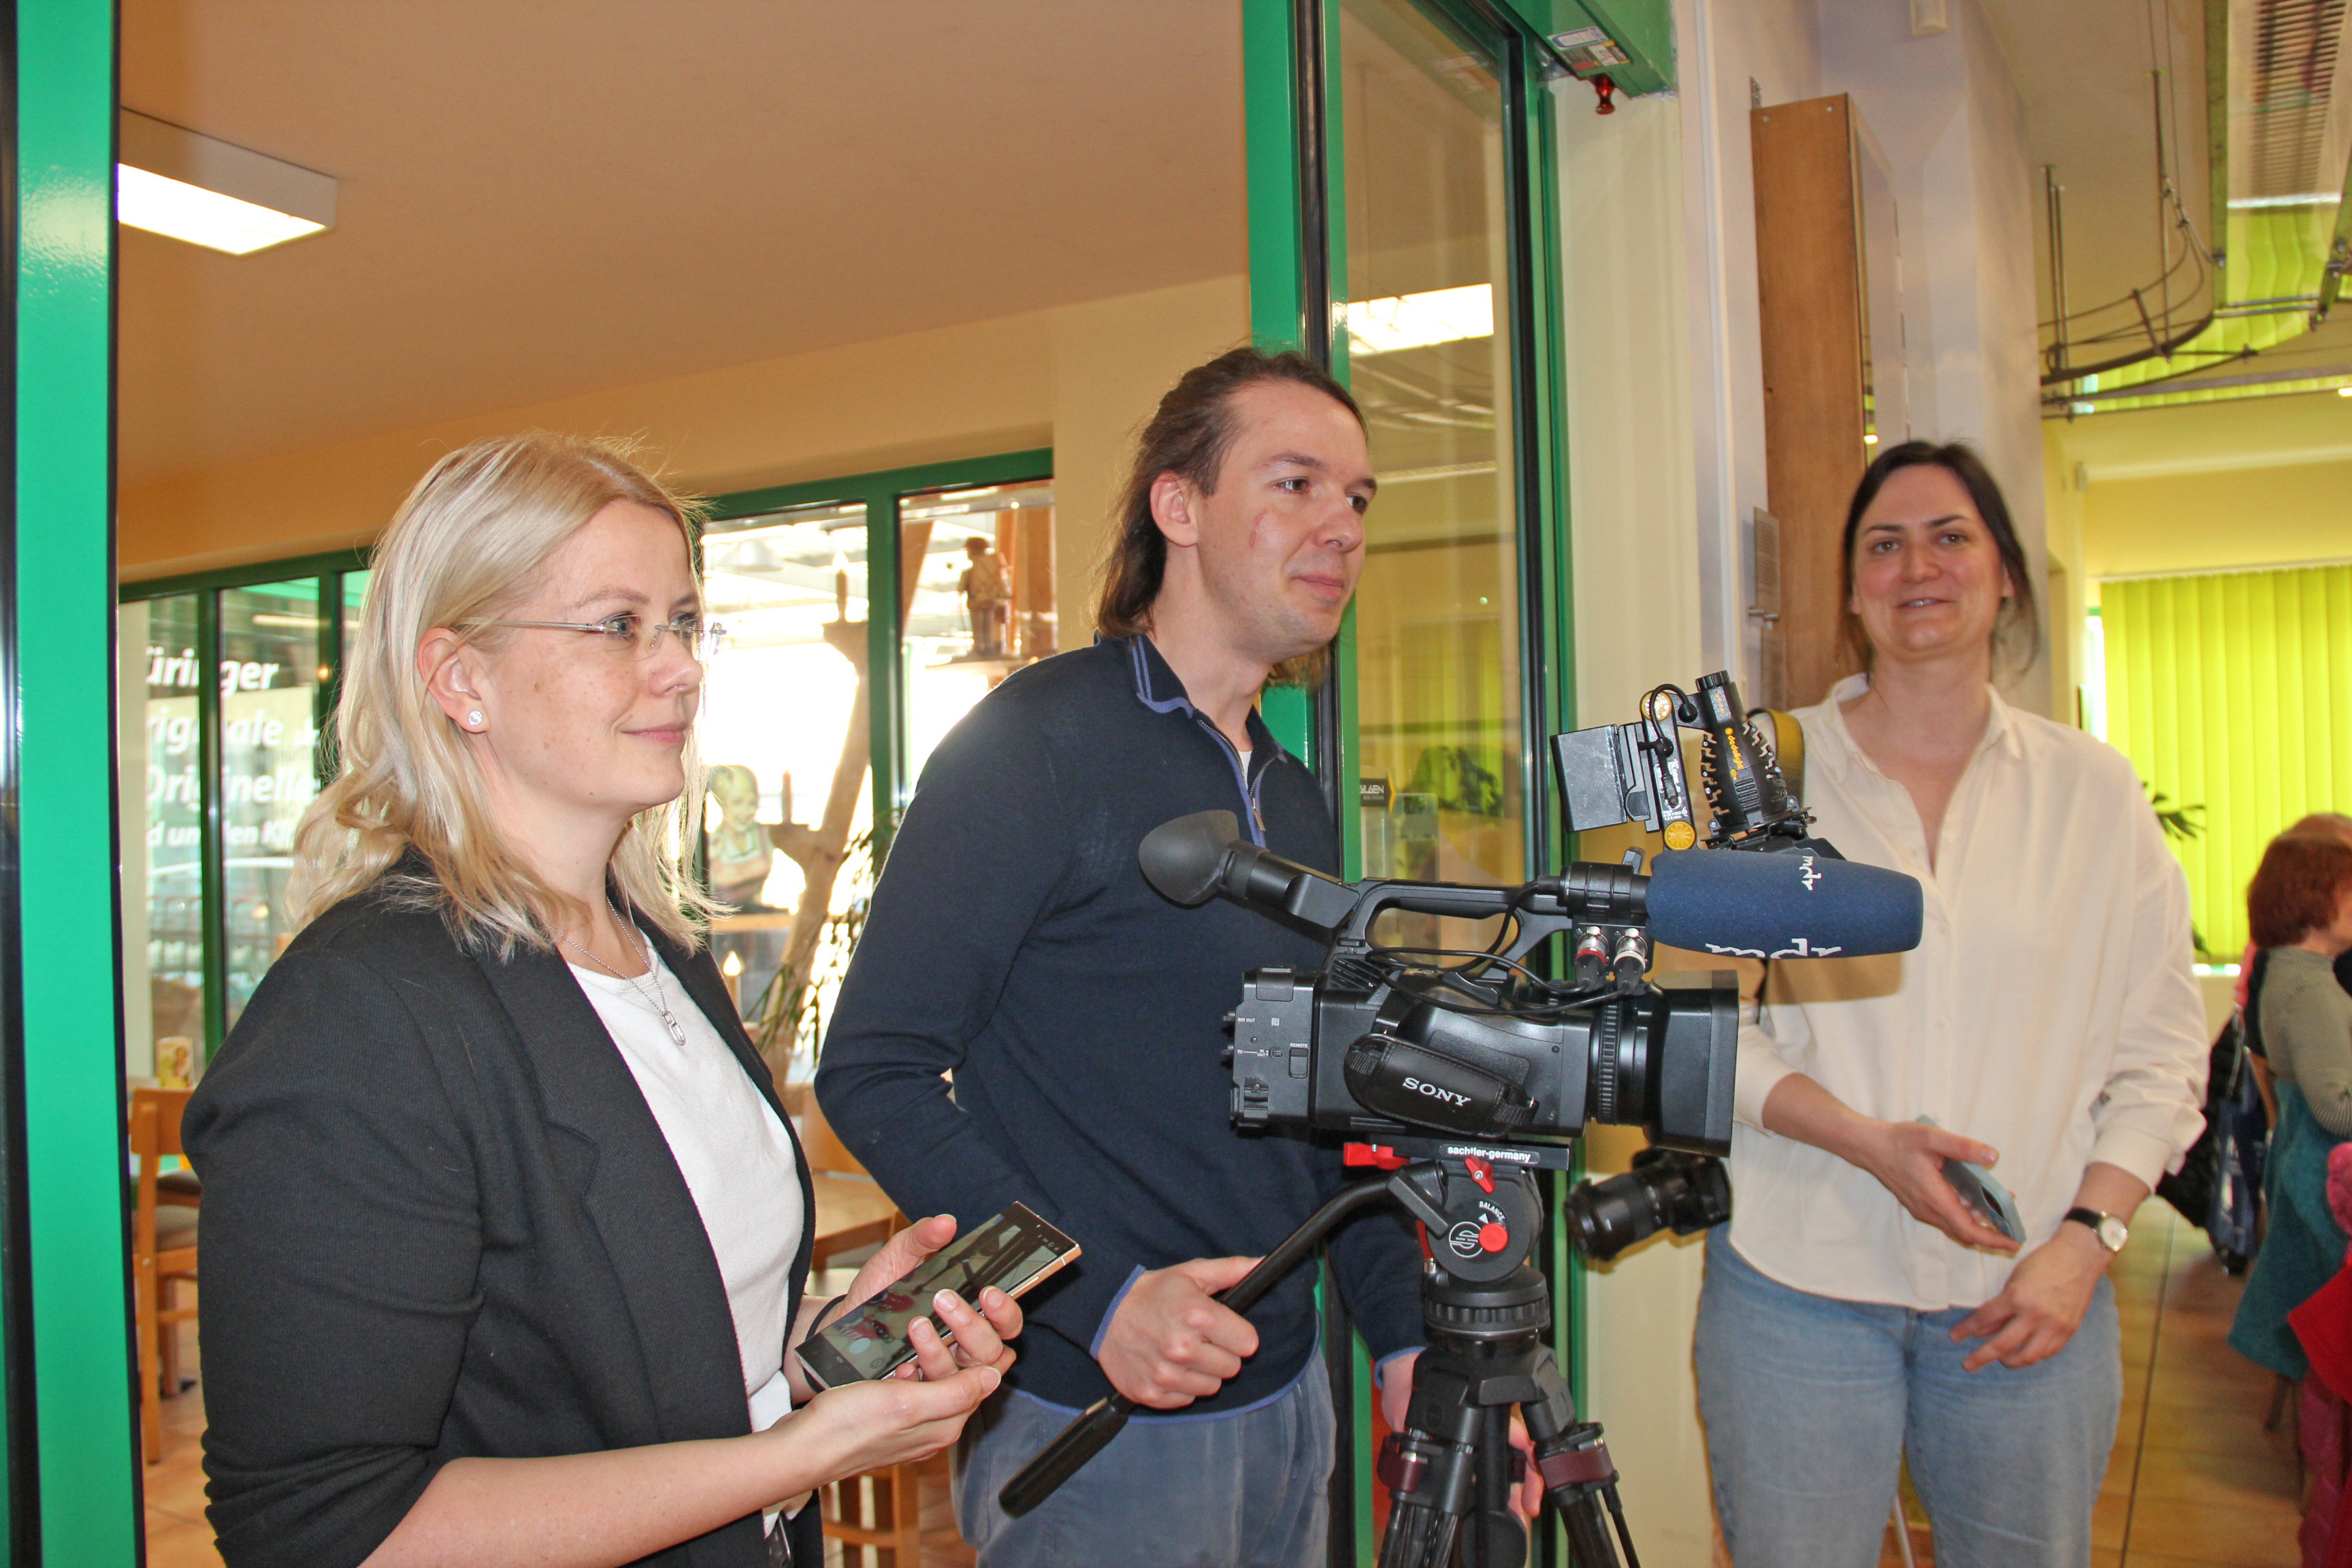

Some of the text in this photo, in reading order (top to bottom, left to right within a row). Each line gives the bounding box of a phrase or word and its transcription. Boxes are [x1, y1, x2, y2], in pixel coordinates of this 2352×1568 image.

[1728, 735, 1744, 769] dedolight
[1799, 855, 1822, 891] mdr
[1705, 938, 1842, 959] mdr
[1403, 1077, 1471, 1107] SONY
[1448, 1146, 1531, 1163] sachtler-germany
[1480, 1200, 1506, 1222] BALANCE
